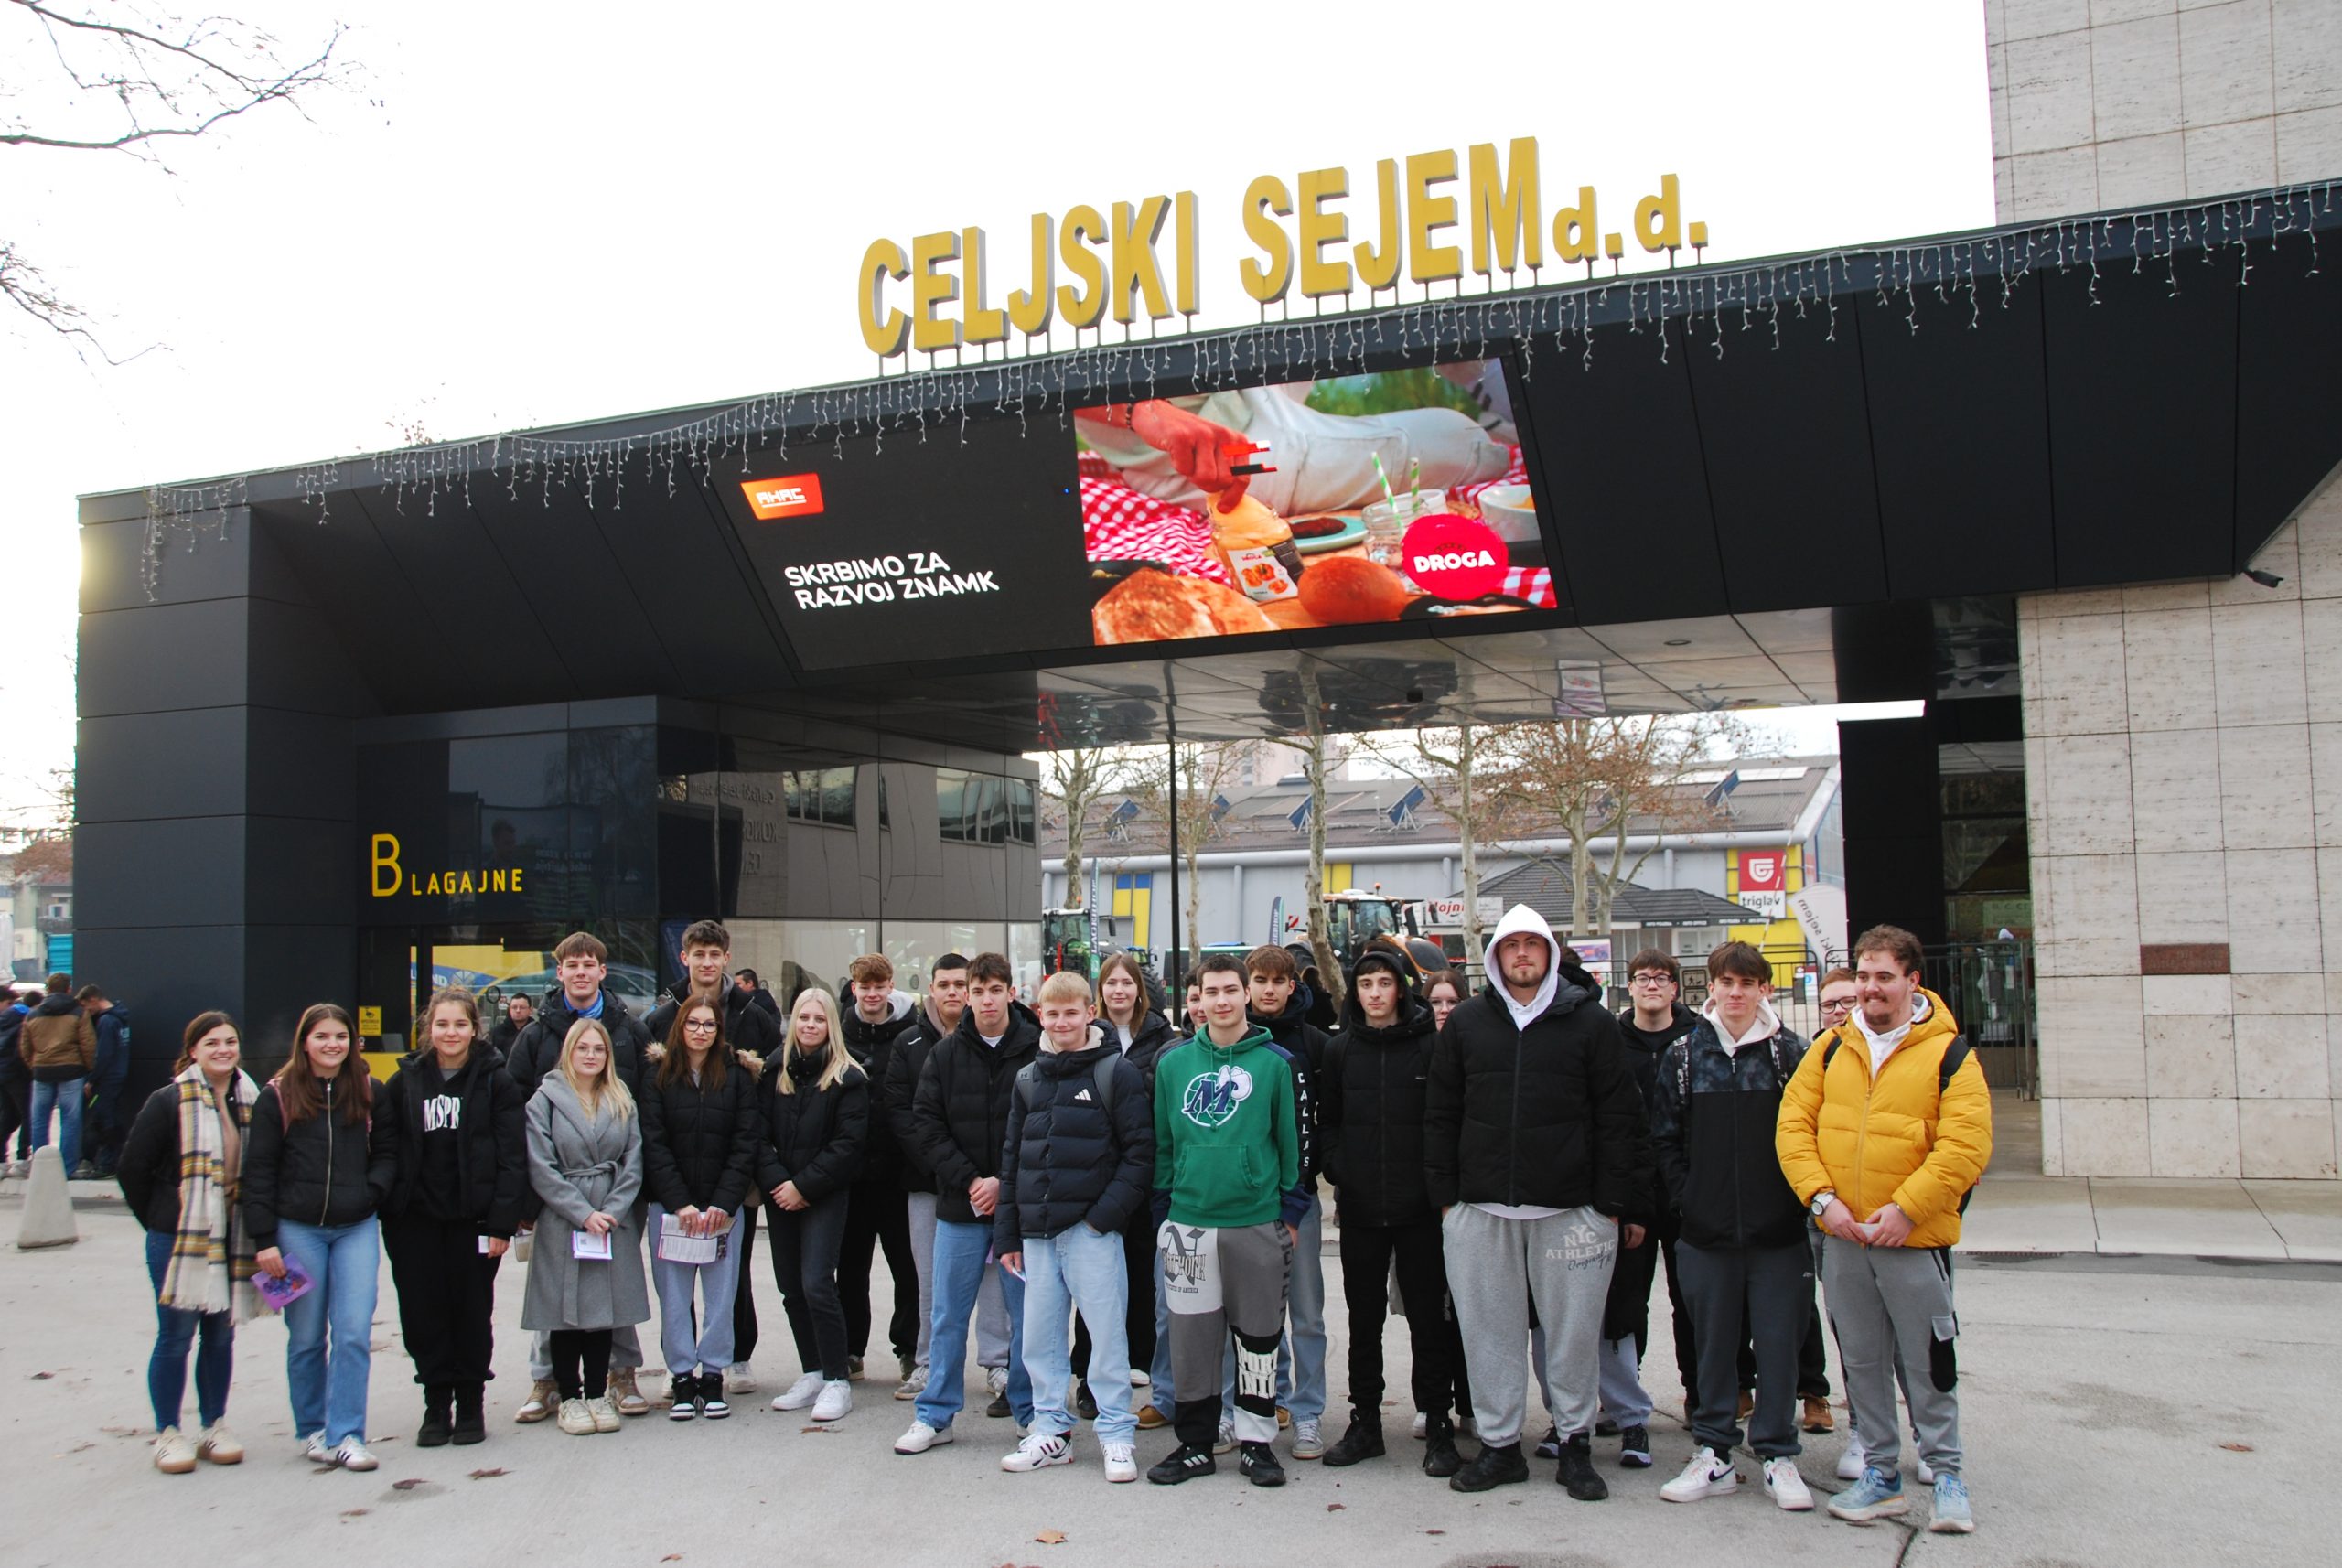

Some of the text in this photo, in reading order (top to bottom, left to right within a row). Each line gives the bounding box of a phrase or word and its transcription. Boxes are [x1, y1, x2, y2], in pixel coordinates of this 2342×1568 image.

[858, 189, 1200, 359] CELJSKI
[1240, 136, 1542, 305] SEJEM
[784, 551, 950, 587] SKRBIMO ZA
[1413, 550, 1496, 573] DROGA
[794, 570, 1000, 610] RAZVOJ ZNAMK
[371, 832, 523, 897] BLAGAJNE
[1741, 895, 1781, 909] triglav
[1545, 1240, 1616, 1260] ATHLETIC
